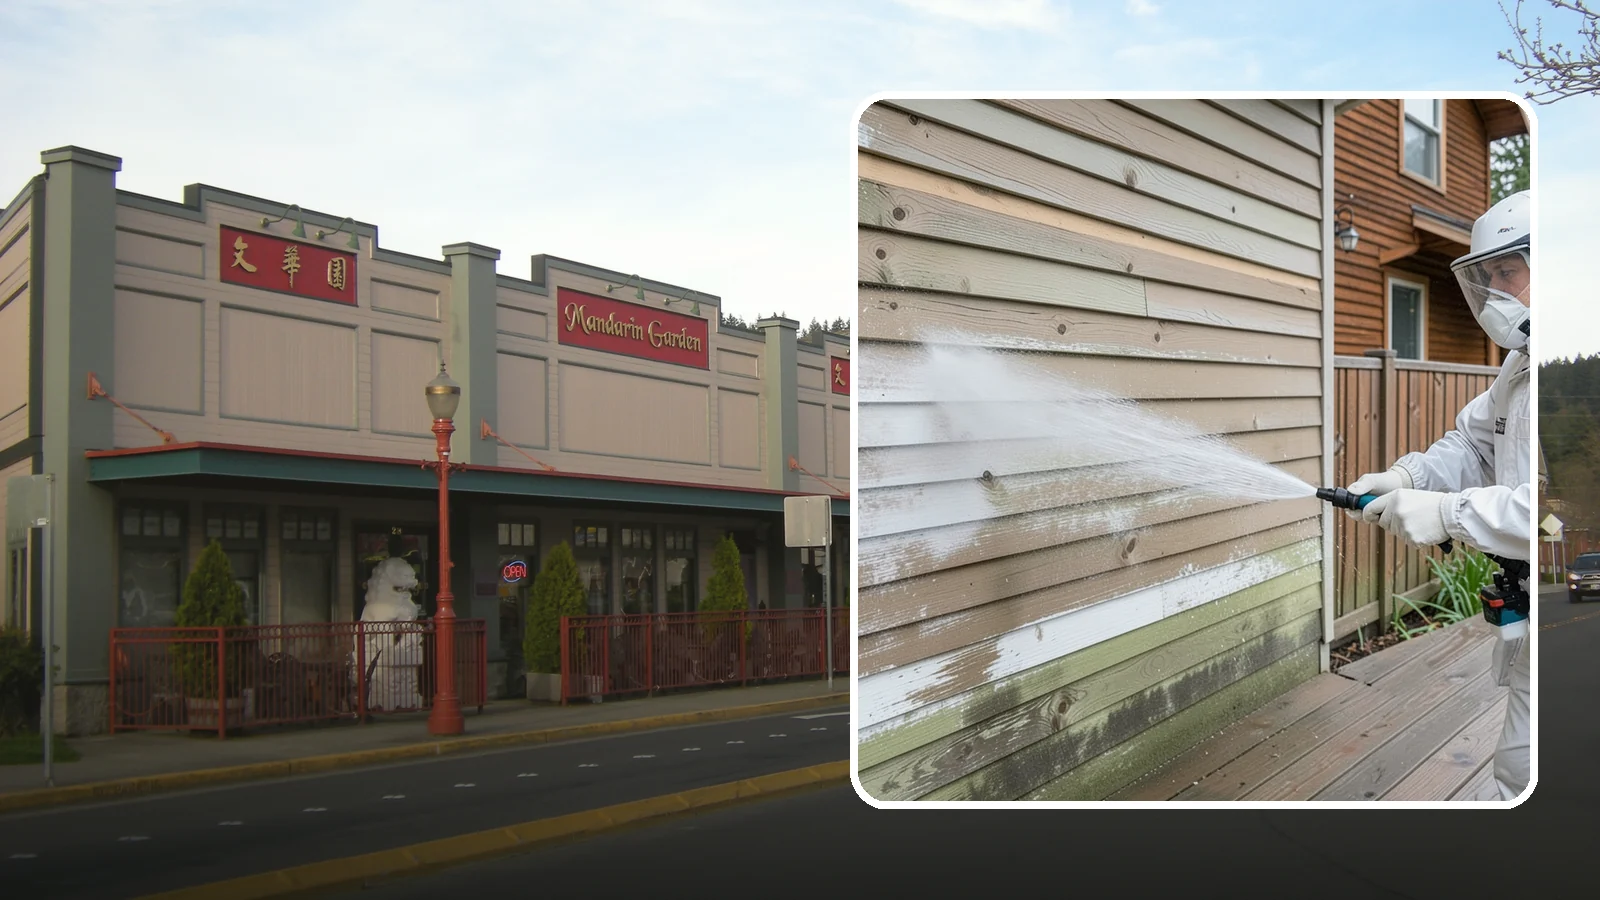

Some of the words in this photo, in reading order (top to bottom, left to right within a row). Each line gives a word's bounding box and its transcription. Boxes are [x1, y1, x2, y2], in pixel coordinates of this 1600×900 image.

[231, 236, 346, 291] 文華園
[564, 302, 644, 341] Mandarin
[648, 320, 701, 352] Garden
[503, 565, 527, 578] OPEN
